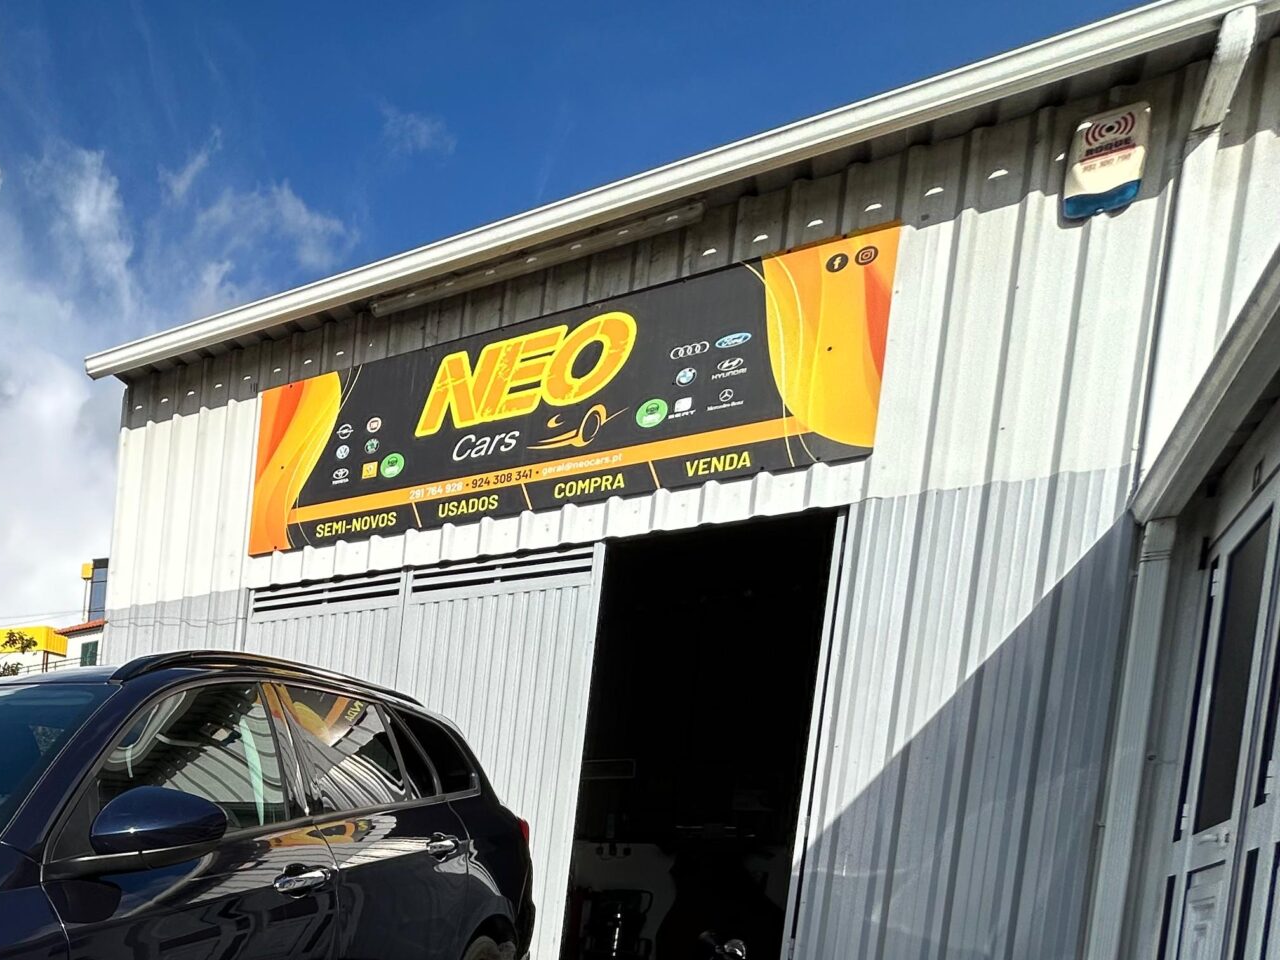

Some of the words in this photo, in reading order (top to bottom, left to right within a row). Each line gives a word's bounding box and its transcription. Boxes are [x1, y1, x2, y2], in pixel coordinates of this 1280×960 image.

[414, 311, 638, 438] NEO
[452, 429, 519, 461] Cars
[685, 451, 751, 477] VENDA
[471, 478, 490, 489] 924
[493, 473, 513, 485] 308
[515, 469, 533, 480] 341
[553, 473, 625, 499] COMPRA
[437, 494, 499, 518] USADOS
[315, 511, 397, 539] SEMI-NOVOS
